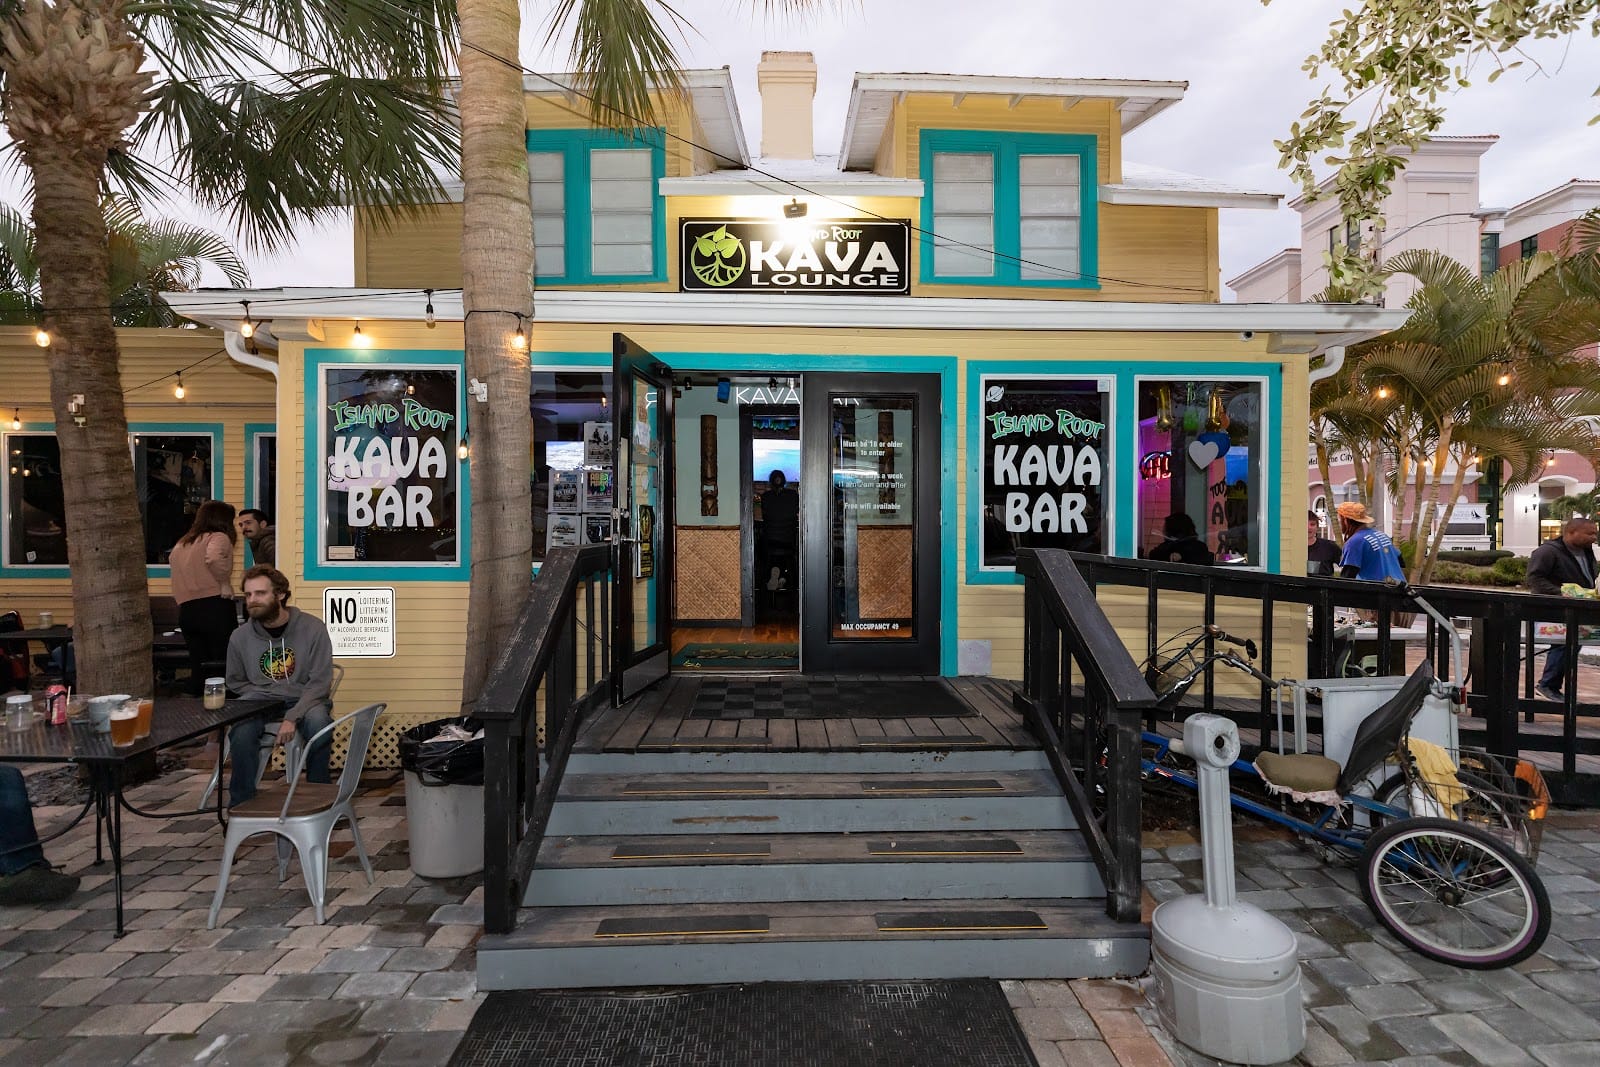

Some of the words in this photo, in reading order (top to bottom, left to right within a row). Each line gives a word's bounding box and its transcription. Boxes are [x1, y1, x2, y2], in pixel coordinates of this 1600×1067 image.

[750, 240, 900, 272] KAVA
[751, 273, 898, 286] LOUNGE
[736, 386, 800, 405] KAVA
[328, 400, 399, 431] ISLAND
[402, 399, 454, 431] ROOT
[987, 411, 1054, 440] ISLAND
[1057, 409, 1105, 438] ROOT
[334, 436, 447, 479] KAVA
[993, 444, 1101, 487] KAVA
[890, 481, 906, 489] after
[348, 485, 434, 527] BAR
[1005, 492, 1088, 533] BAR
[330, 597, 357, 624] NO
[360, 597, 389, 605] LOITERING
[360, 616, 388, 624] DRINKING
